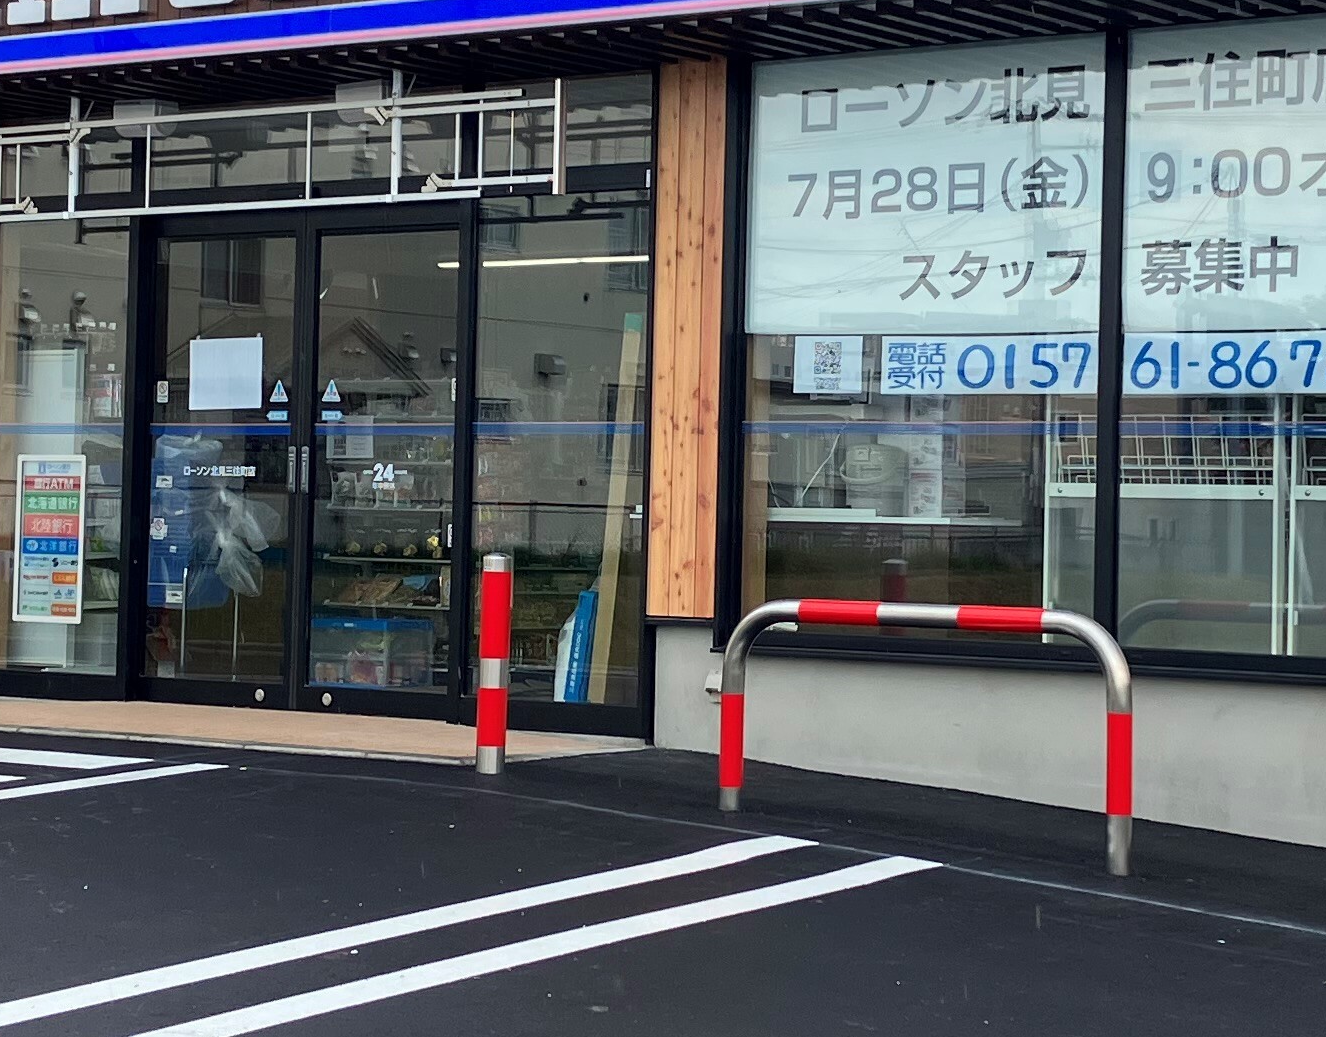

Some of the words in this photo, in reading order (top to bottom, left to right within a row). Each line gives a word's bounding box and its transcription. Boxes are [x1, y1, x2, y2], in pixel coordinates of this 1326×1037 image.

[801, 65, 1090, 132] ローソン北見
[899, 250, 1088, 301] スタッフ
[1141, 236, 1299, 296] 募集中
[887, 342, 948, 365] 電話
[957, 342, 1092, 390] 0157
[887, 365, 946, 390] 受付
[373, 463, 395, 482] 24
